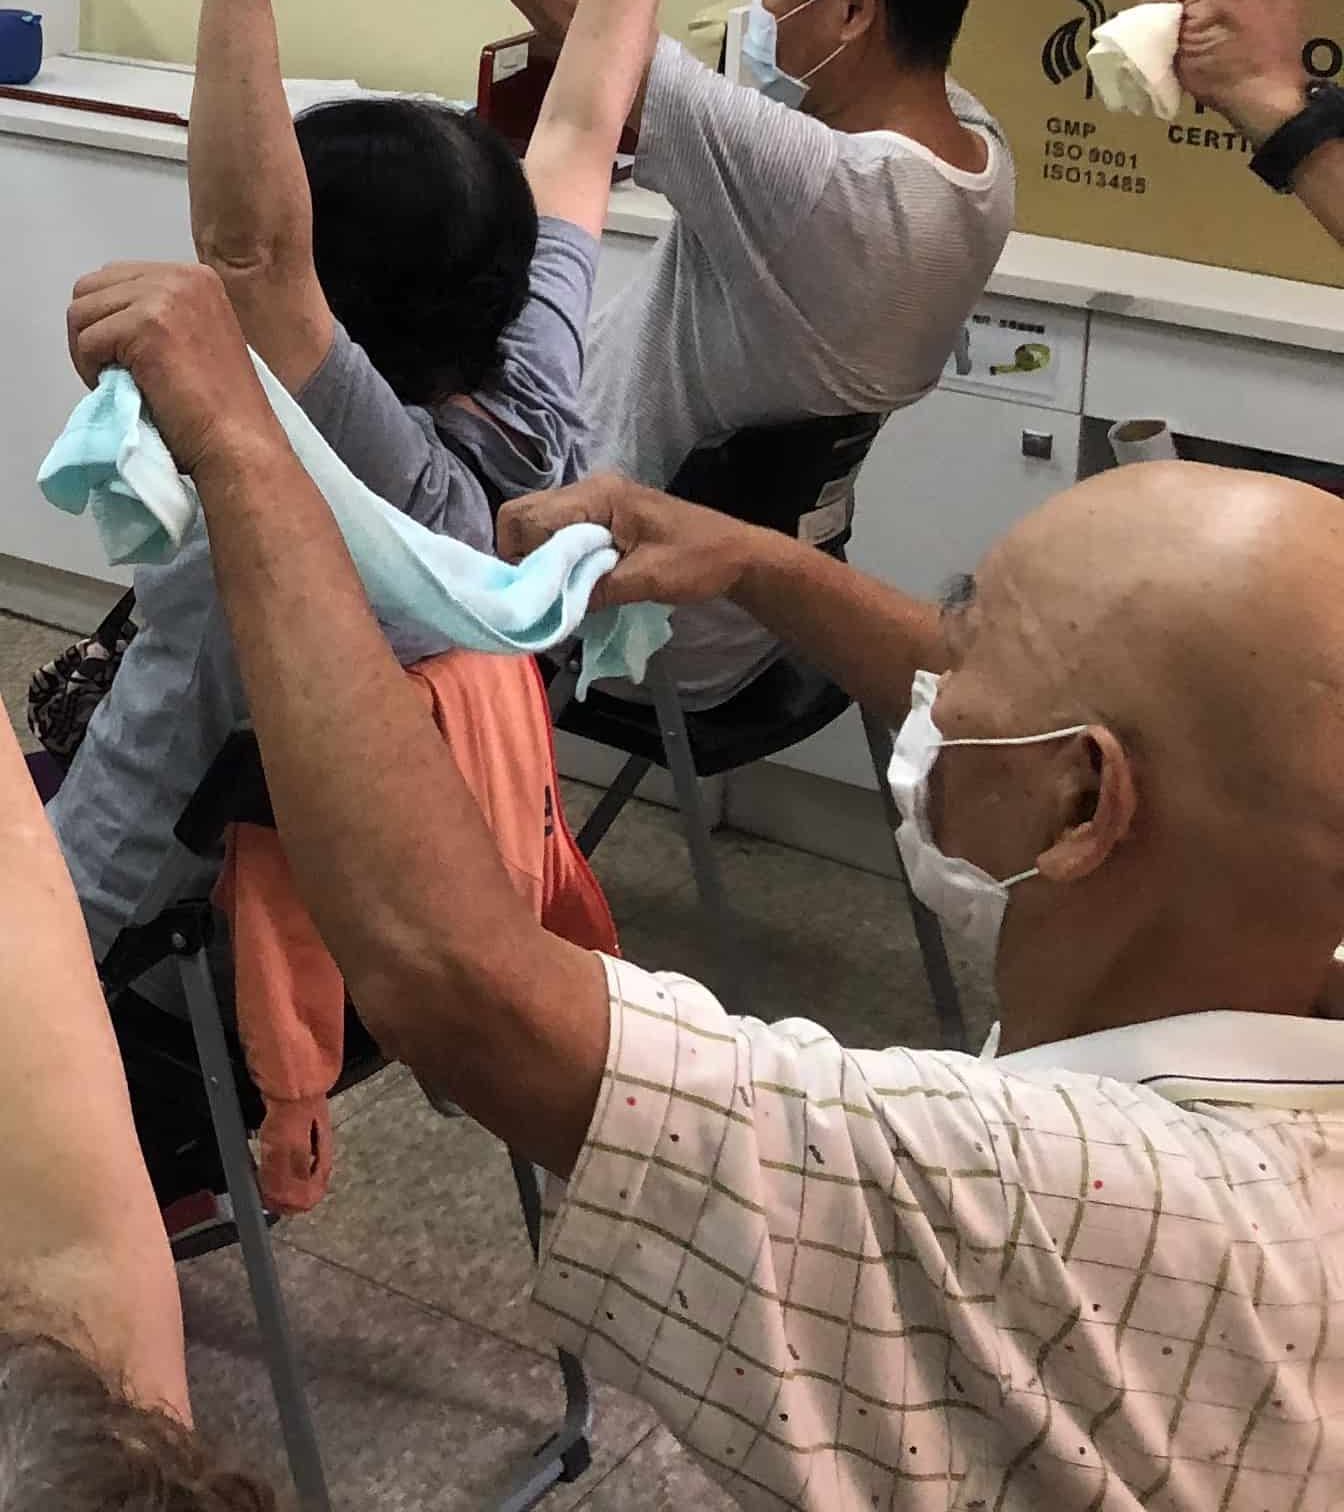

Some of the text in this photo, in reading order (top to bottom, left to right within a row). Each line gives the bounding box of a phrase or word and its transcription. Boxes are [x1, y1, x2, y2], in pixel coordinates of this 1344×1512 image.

[1046, 117, 1097, 138] GMP
[1167, 124, 1248, 153] CERTI
[1045, 140, 1083, 161] ISO
